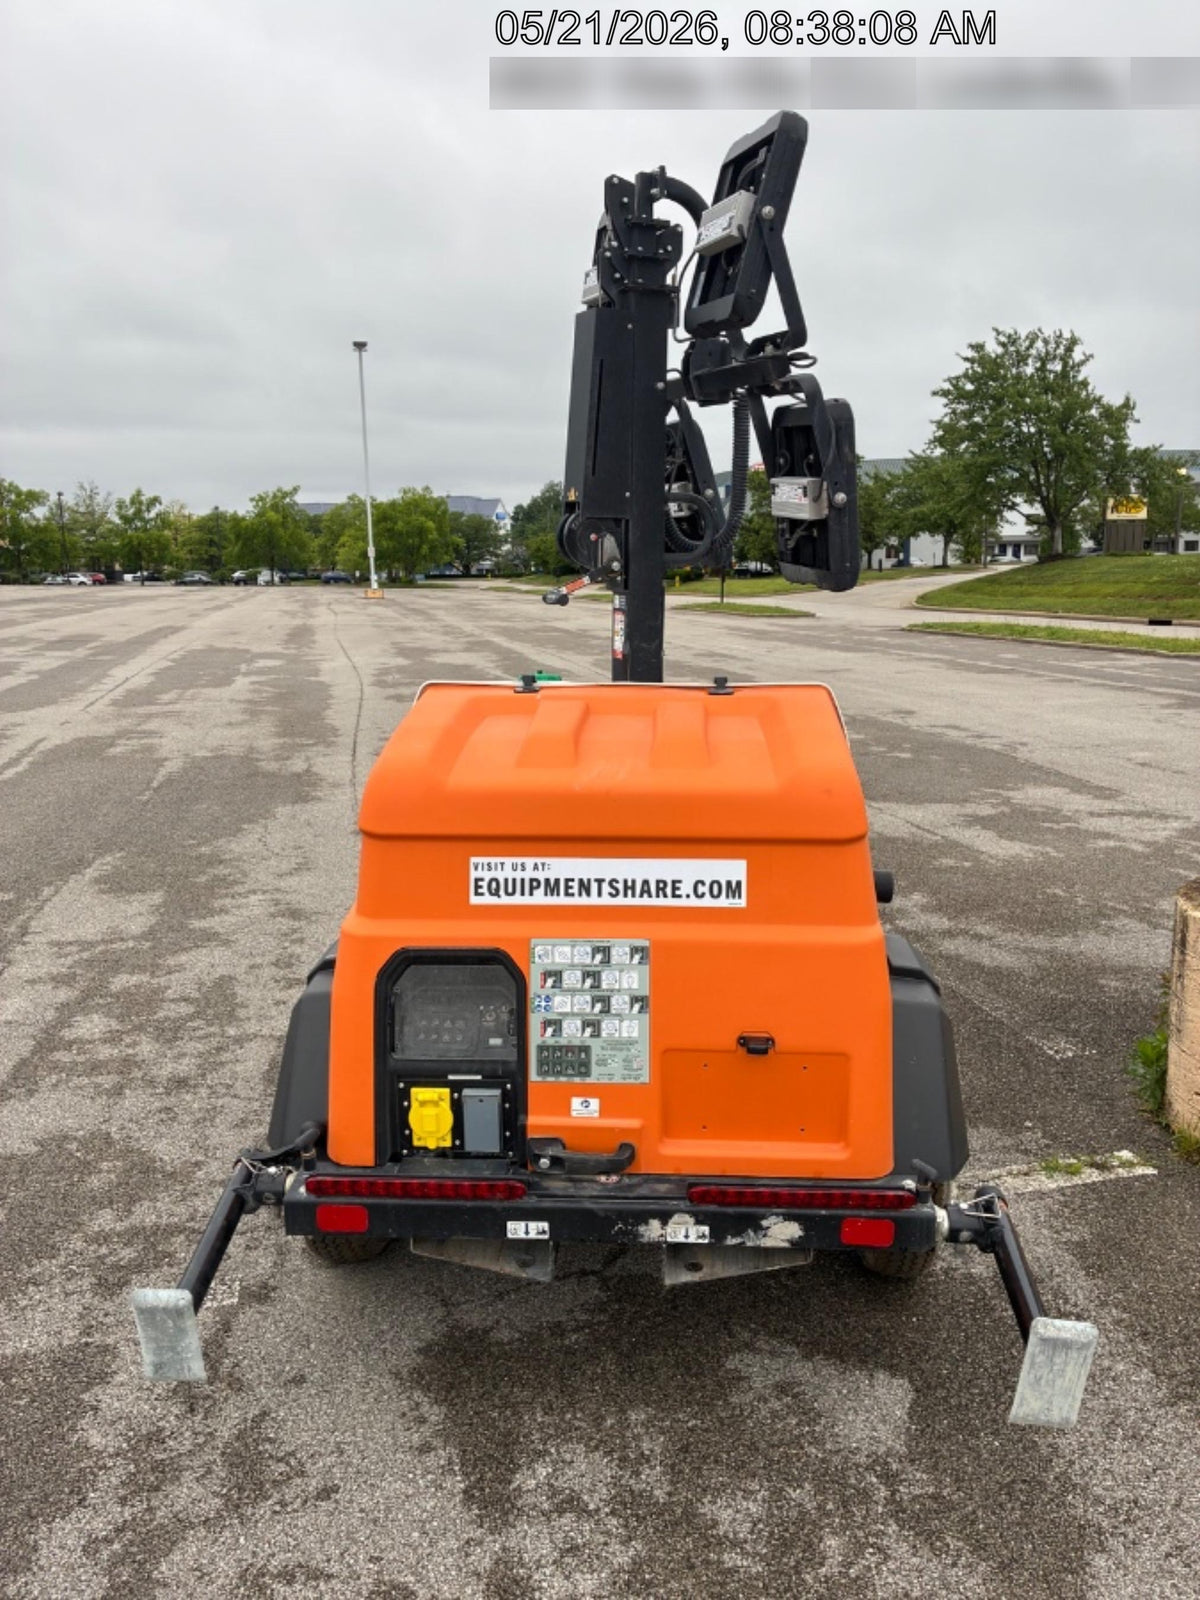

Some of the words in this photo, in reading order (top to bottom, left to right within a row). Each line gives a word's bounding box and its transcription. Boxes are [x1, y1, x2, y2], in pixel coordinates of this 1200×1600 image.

[472, 861, 506, 872] VISIT
[511, 862, 527, 872] US
[532, 862, 552, 872] AT:
[473, 877, 743, 900] EQUIPMENTSHARE.COM
